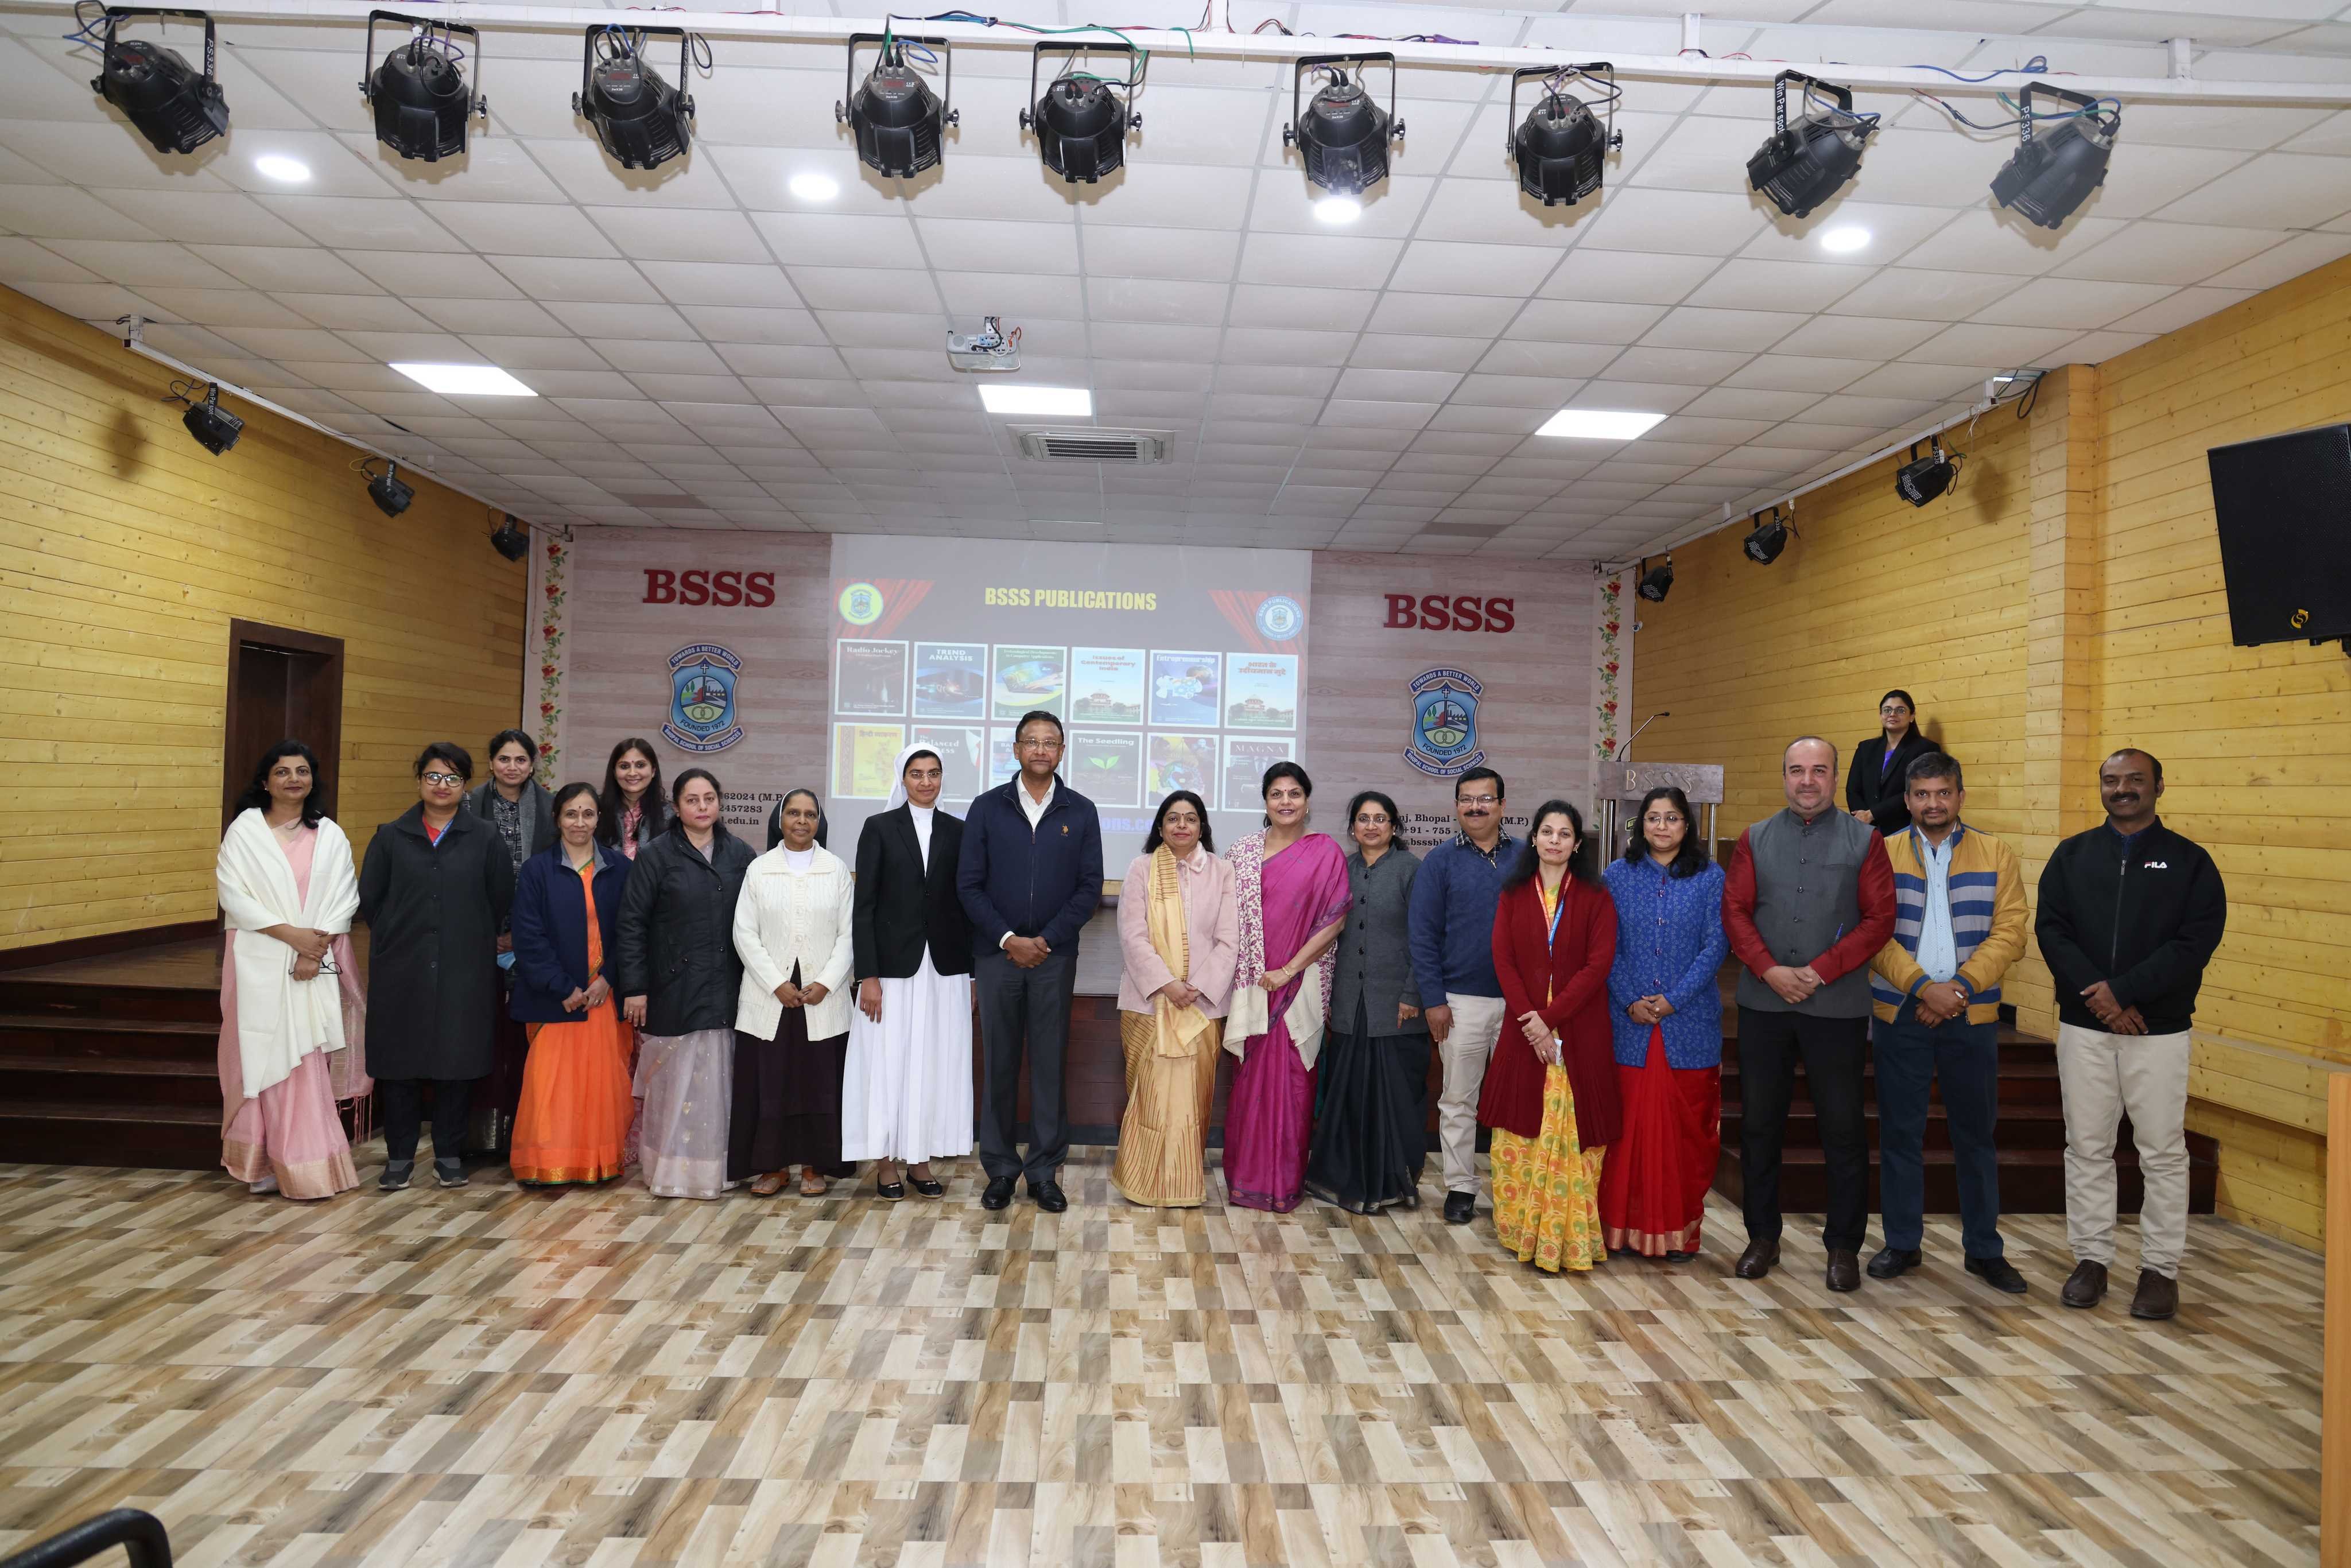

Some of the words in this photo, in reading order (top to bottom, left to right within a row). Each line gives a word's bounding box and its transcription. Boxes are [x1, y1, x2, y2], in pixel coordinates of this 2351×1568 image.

[1777, 98, 1785, 114] Par
[1776, 115, 1786, 134] spot
[643, 569, 775, 608] BSSS
[985, 588, 1030, 606] BSSS
[1034, 589, 1157, 611] PUBLICATIONS
[1383, 594, 1515, 634] BSSS
[670, 647, 695, 664] TOWARDS
[701, 646, 721, 654] BETTER
[722, 651, 739, 666] WORLD
[871, 647, 898, 656] Jockey
[1413, 672, 1437, 688] TOWARDS
[1442, 670, 1462, 678] BETTER
[1463, 675, 1480, 690] WORLD
[680, 719, 710, 732] FOUNDED
[712, 720, 725, 730] 1972
[664, 728, 679, 743] BHOPAL
[680, 740, 697, 750] SCHOOL
[721, 731, 741, 746] SCIENCES
[1096, 738, 1135, 746] Seedling
[1235, 744, 1287, 753] MAGNA
[1422, 743, 1452, 756] FOUNDED
[1454, 744, 1467, 755] 1972
[1407, 752, 1422, 767] BHOPAL
[1422, 764, 1439, 774] SCHOOL
[1463, 755, 1483, 770] SCIENCES
[721, 792, 755, 801] 62024
[758, 793, 787, 802] (M.P
[1415, 814, 1450, 824] Bhopal
[1500, 817, 1529, 826] (M.P.)
